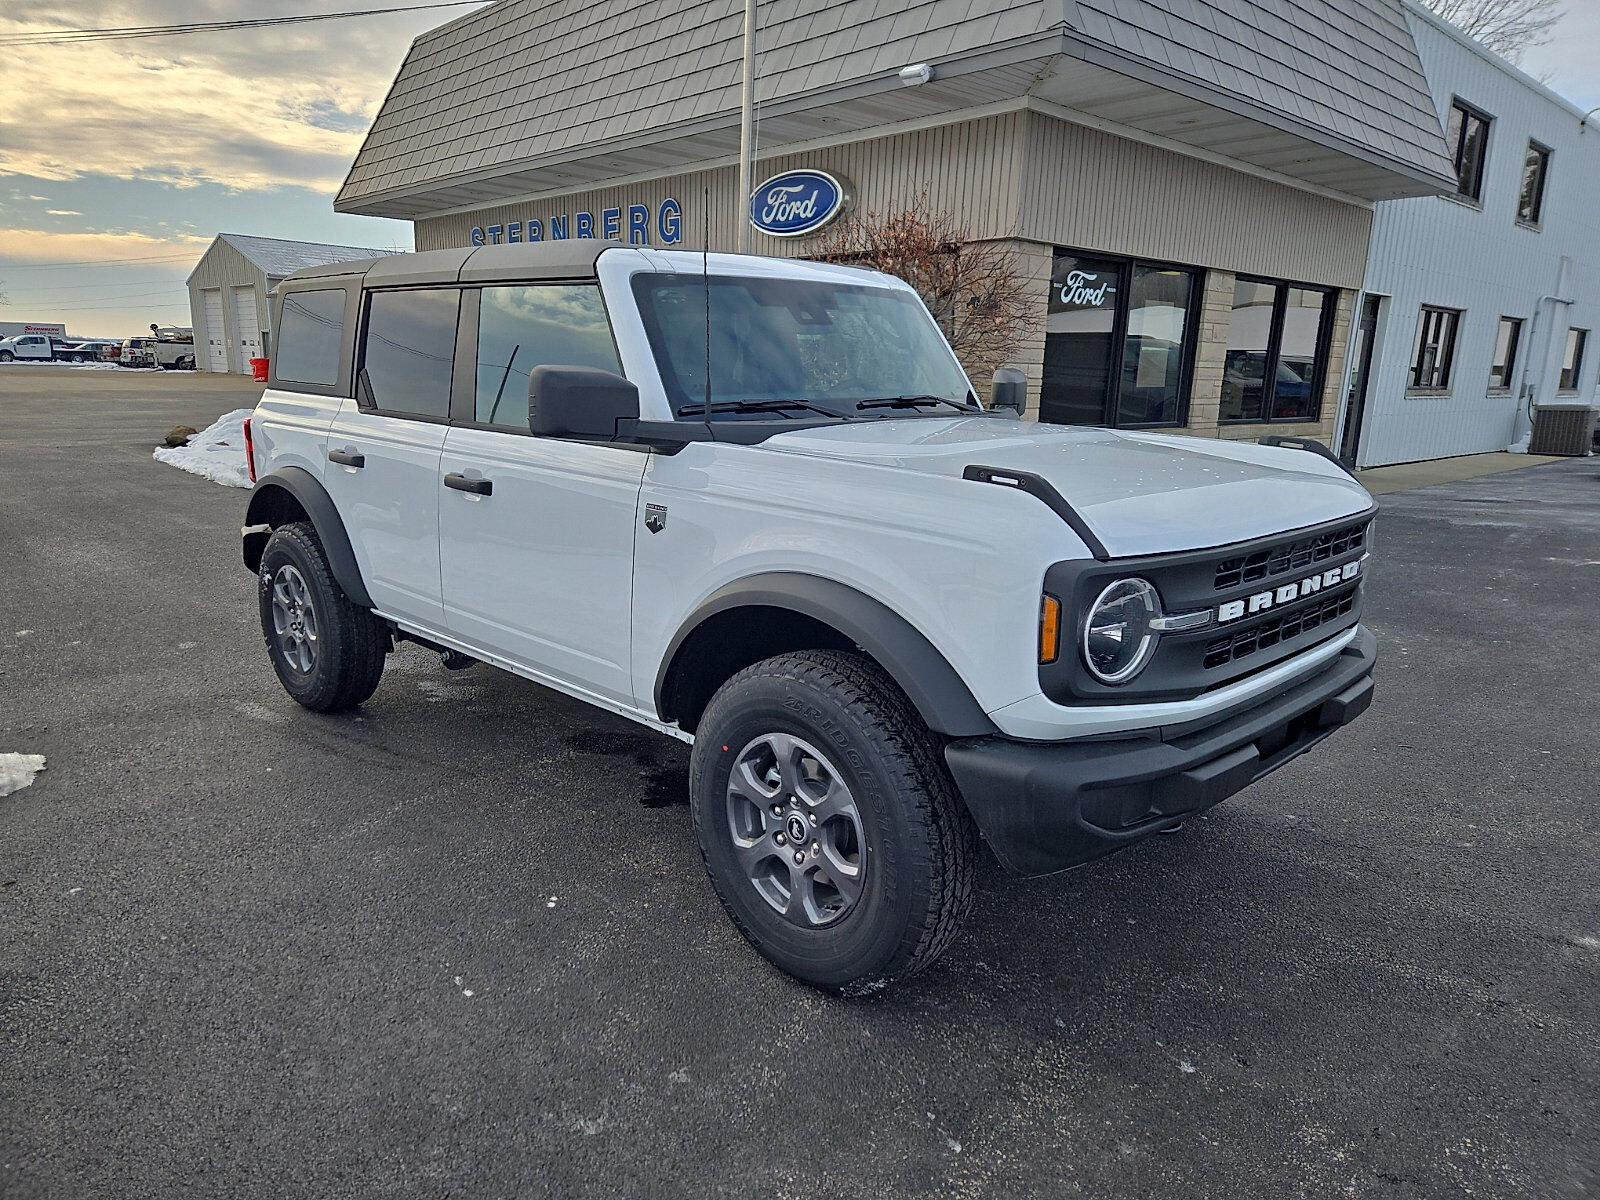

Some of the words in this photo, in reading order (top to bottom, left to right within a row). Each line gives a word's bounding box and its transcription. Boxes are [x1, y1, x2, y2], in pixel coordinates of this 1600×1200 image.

[471, 197, 683, 248] STERNBERG
[762, 184, 819, 224] Ford
[1060, 270, 1108, 306] Ford
[1217, 560, 1361, 622] BRONCO
